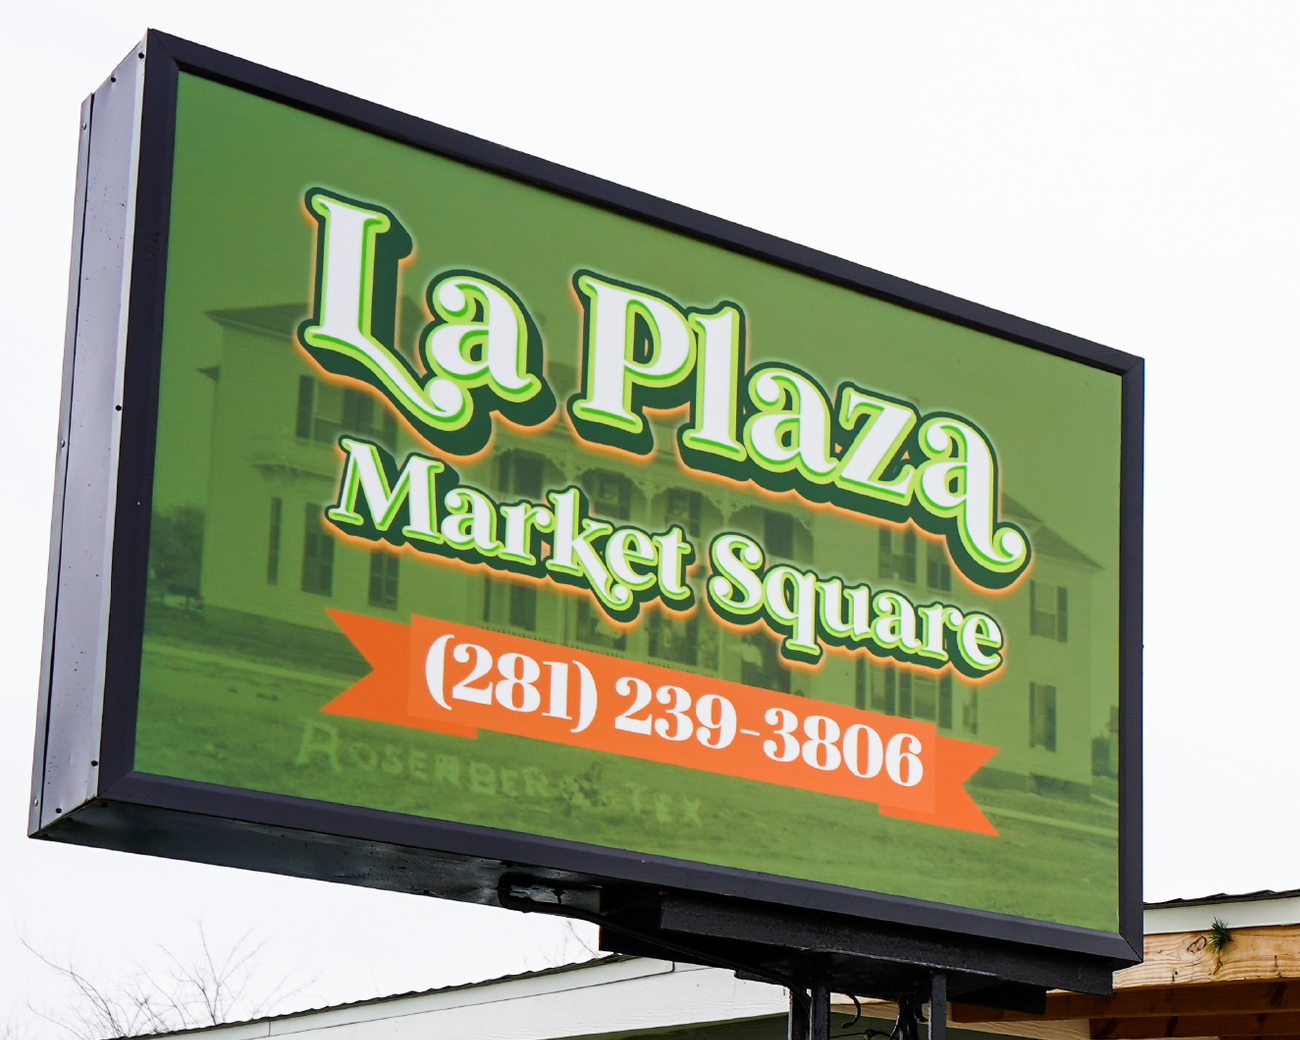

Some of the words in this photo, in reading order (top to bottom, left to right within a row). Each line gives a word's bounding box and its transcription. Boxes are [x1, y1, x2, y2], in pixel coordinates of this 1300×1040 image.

[303, 193, 543, 432] La
[572, 273, 1029, 573] Plaza
[328, 437, 693, 611] Market
[708, 532, 1004, 670] Square
[424, 634, 598, 733] (281)
[614, 676, 924, 787] 239-3806
